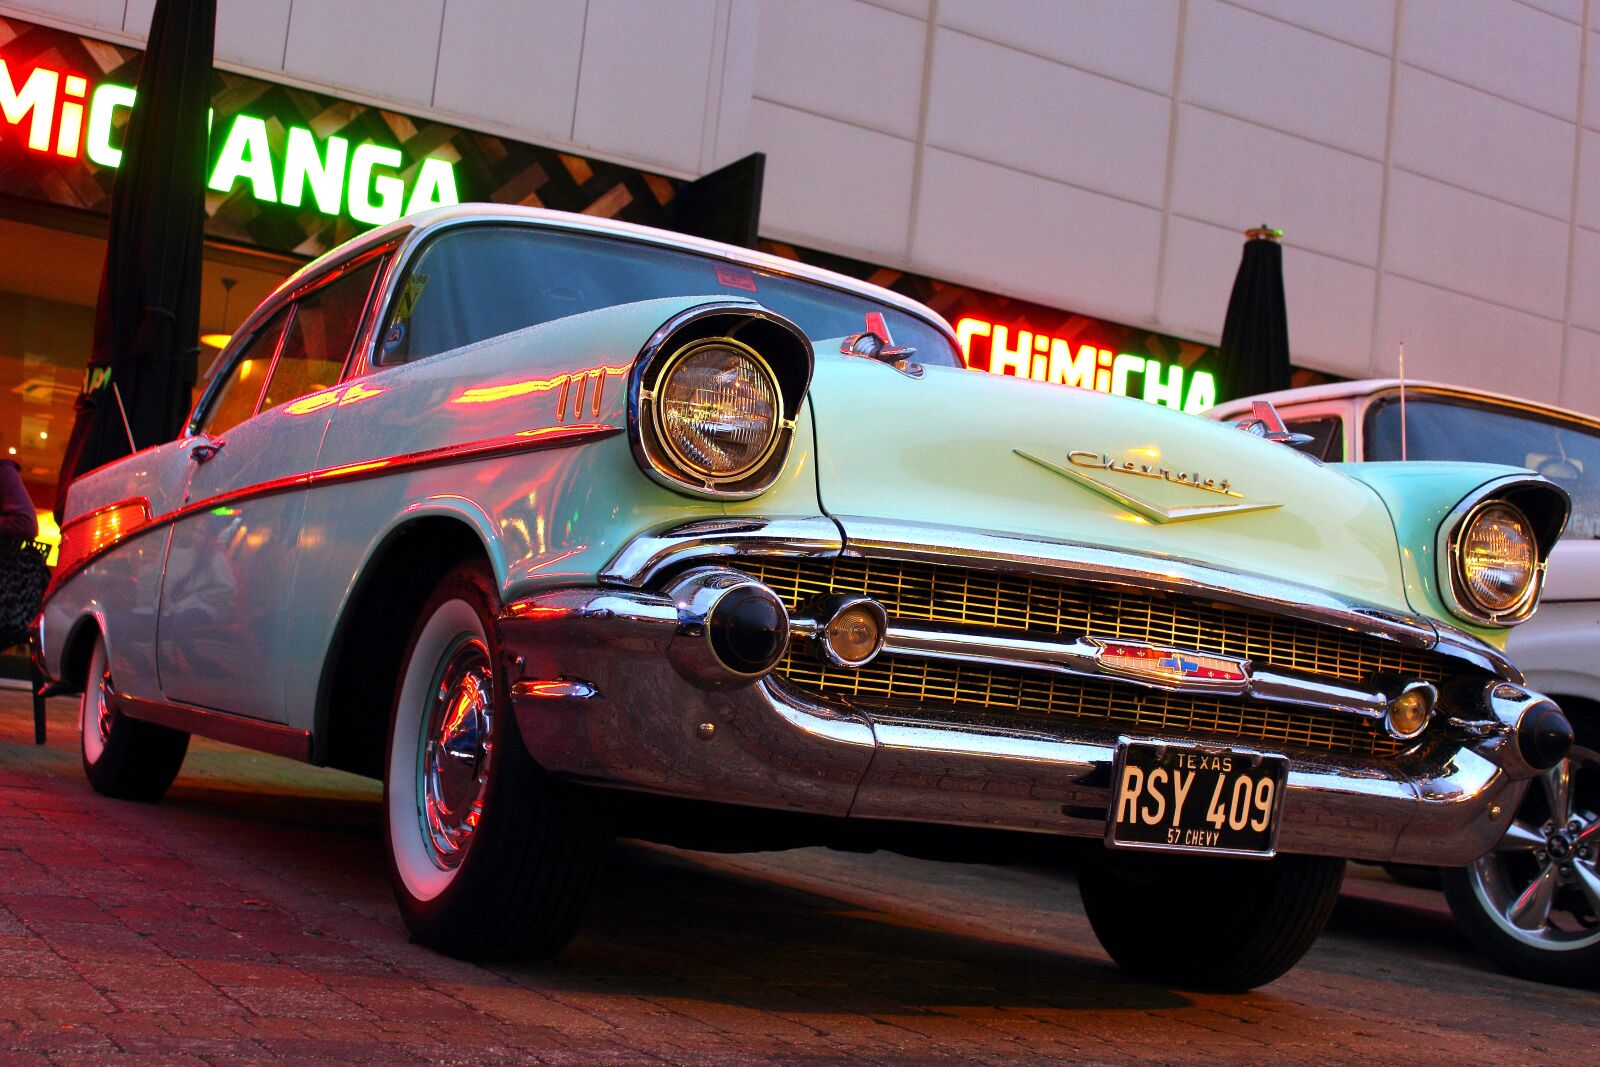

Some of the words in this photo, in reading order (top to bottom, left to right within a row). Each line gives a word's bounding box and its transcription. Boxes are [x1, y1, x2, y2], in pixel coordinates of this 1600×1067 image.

[1067, 450, 1243, 498] Chevrolet
[1177, 754, 1232, 772] TEXAS
[1116, 765, 1196, 827] RSY
[1206, 772, 1275, 832] 409
[1167, 829, 1181, 844] 57
[1185, 830, 1220, 846] CHEVY
